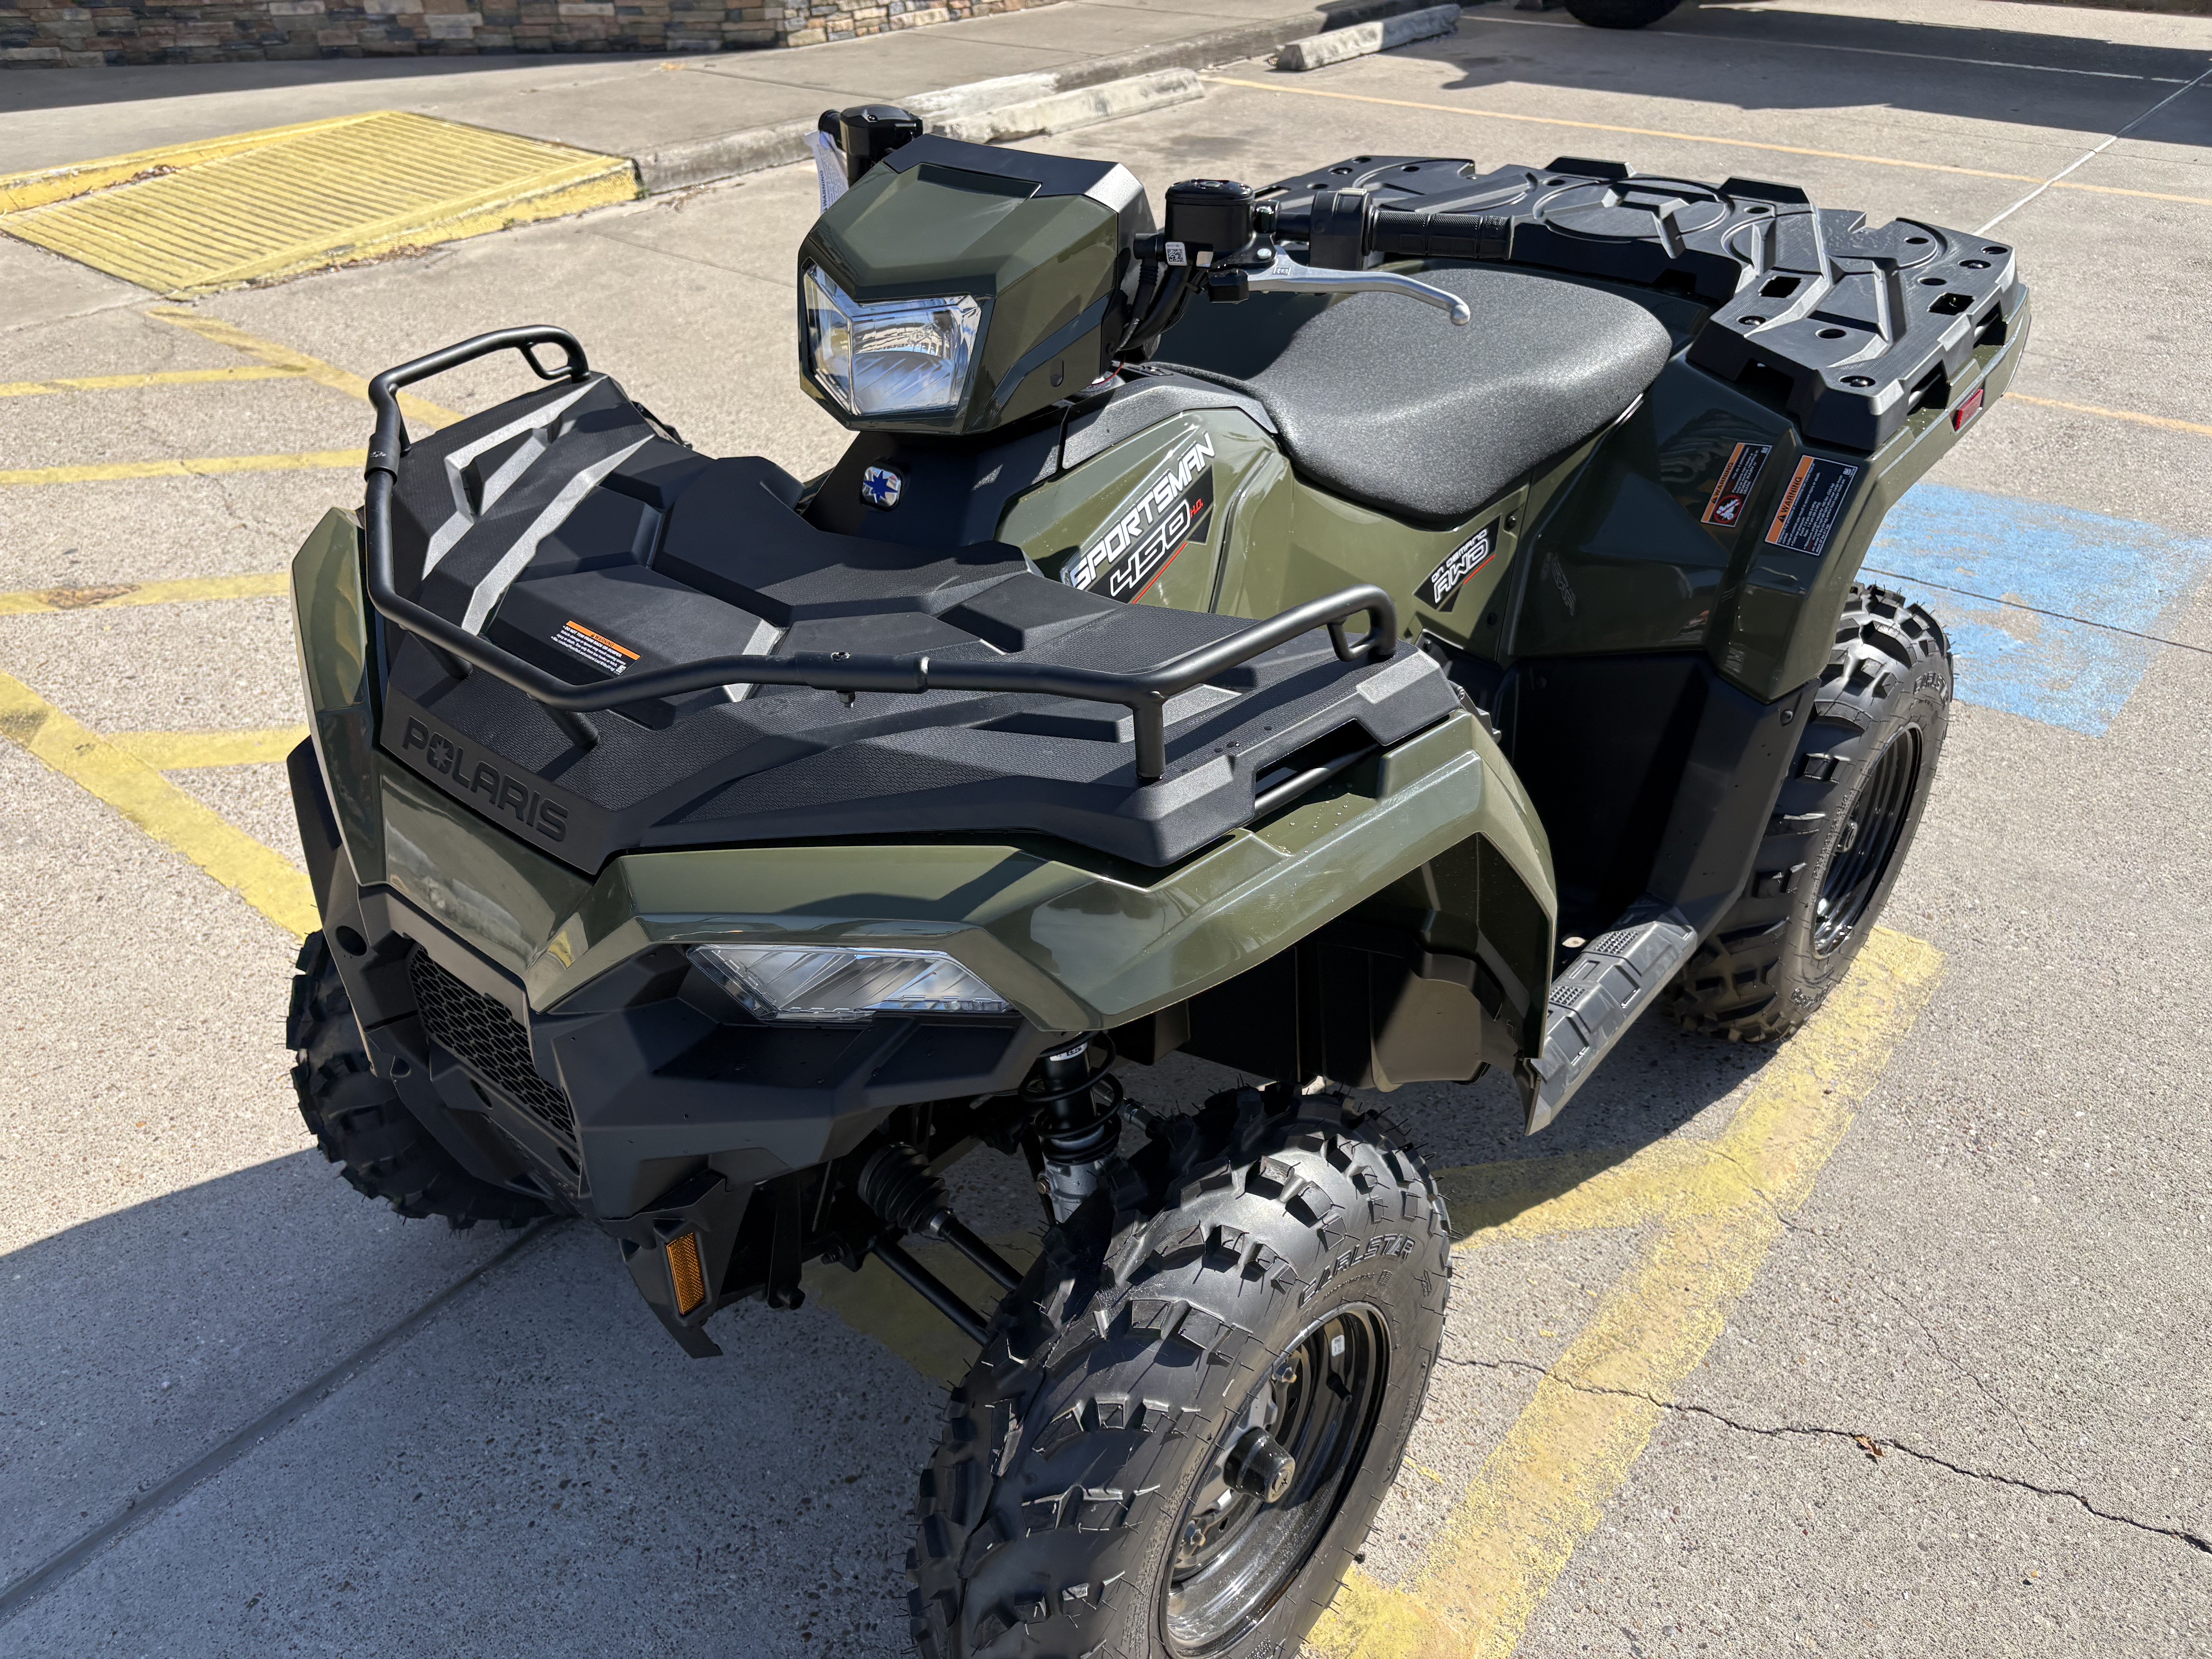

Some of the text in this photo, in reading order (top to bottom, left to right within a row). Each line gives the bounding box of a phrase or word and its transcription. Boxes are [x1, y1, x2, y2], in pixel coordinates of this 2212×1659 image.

[1070, 432, 1215, 591] SPORTSMAN
[1714, 462, 1733, 496] WARNING
[1780, 476, 1803, 513] WARNING
[1110, 500, 1191, 596] 450
[1434, 538, 1489, 604] AWD
[594, 635, 615, 647] WARNING
[402, 715, 569, 842] POLARIS
[1298, 1233, 1416, 1309] CARLSTAR
